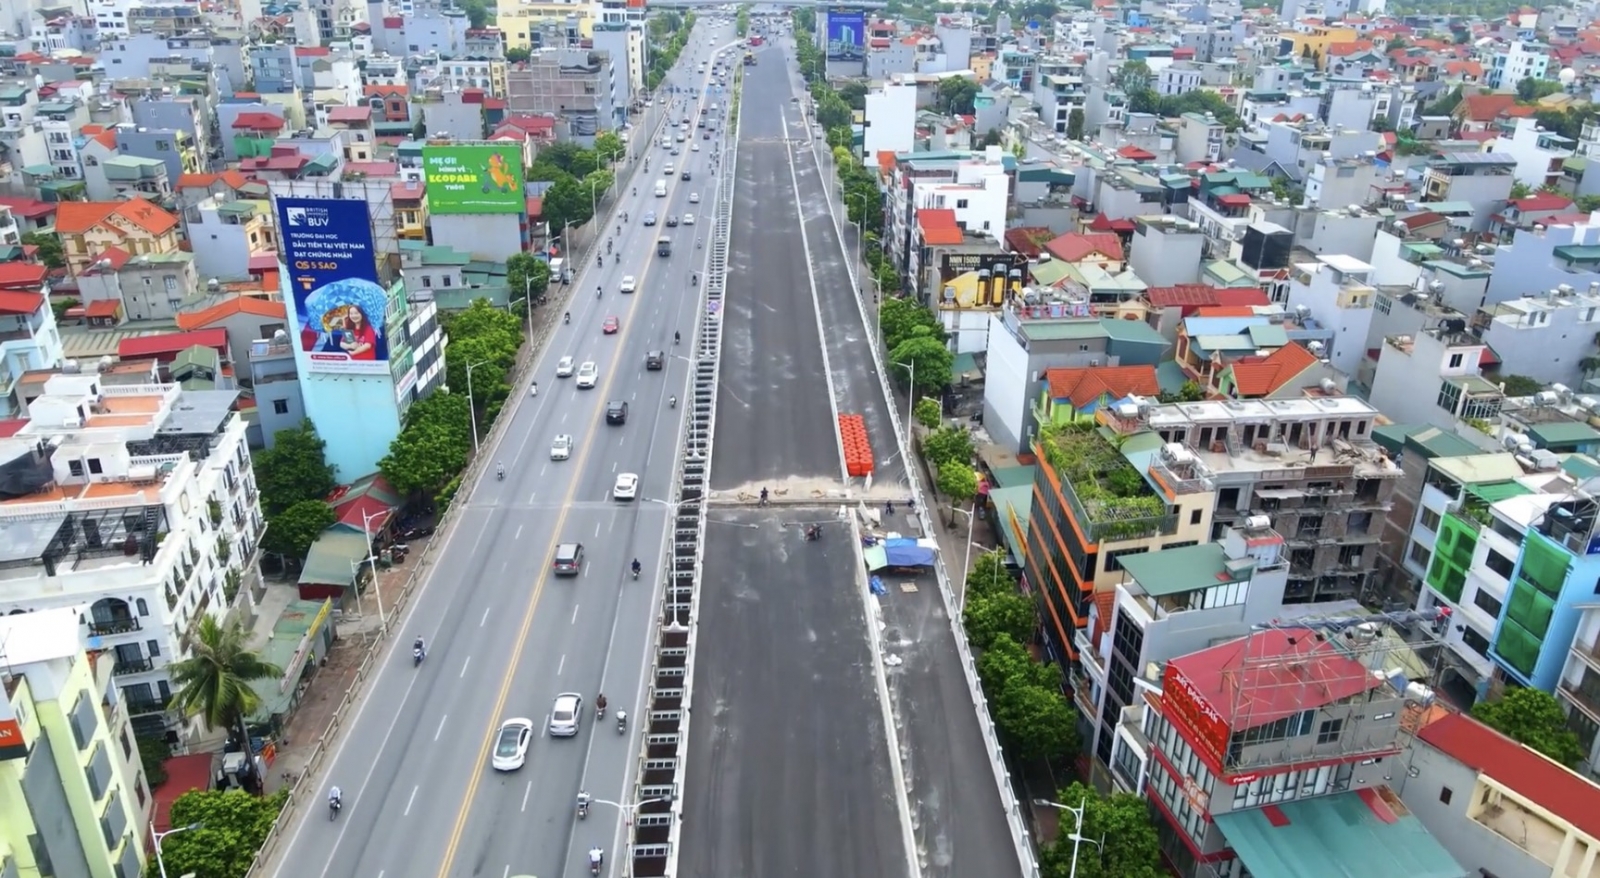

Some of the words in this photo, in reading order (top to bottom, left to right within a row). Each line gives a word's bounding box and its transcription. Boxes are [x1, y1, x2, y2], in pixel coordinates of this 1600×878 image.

[428, 174, 477, 183] ECOPARK
[307, 217, 329, 227] BUV
[292, 240, 306, 248] ĐẦU
[333, 241, 348, 249] VIỆT
[307, 250, 331, 258] CHỨNG
[332, 251, 352, 259] NHẬN
[949, 256, 963, 264] NMN
[963, 256, 981, 264] 15000
[295, 260, 310, 270] QS
[311, 261, 317, 269] 5
[318, 261, 337, 270] SAO
